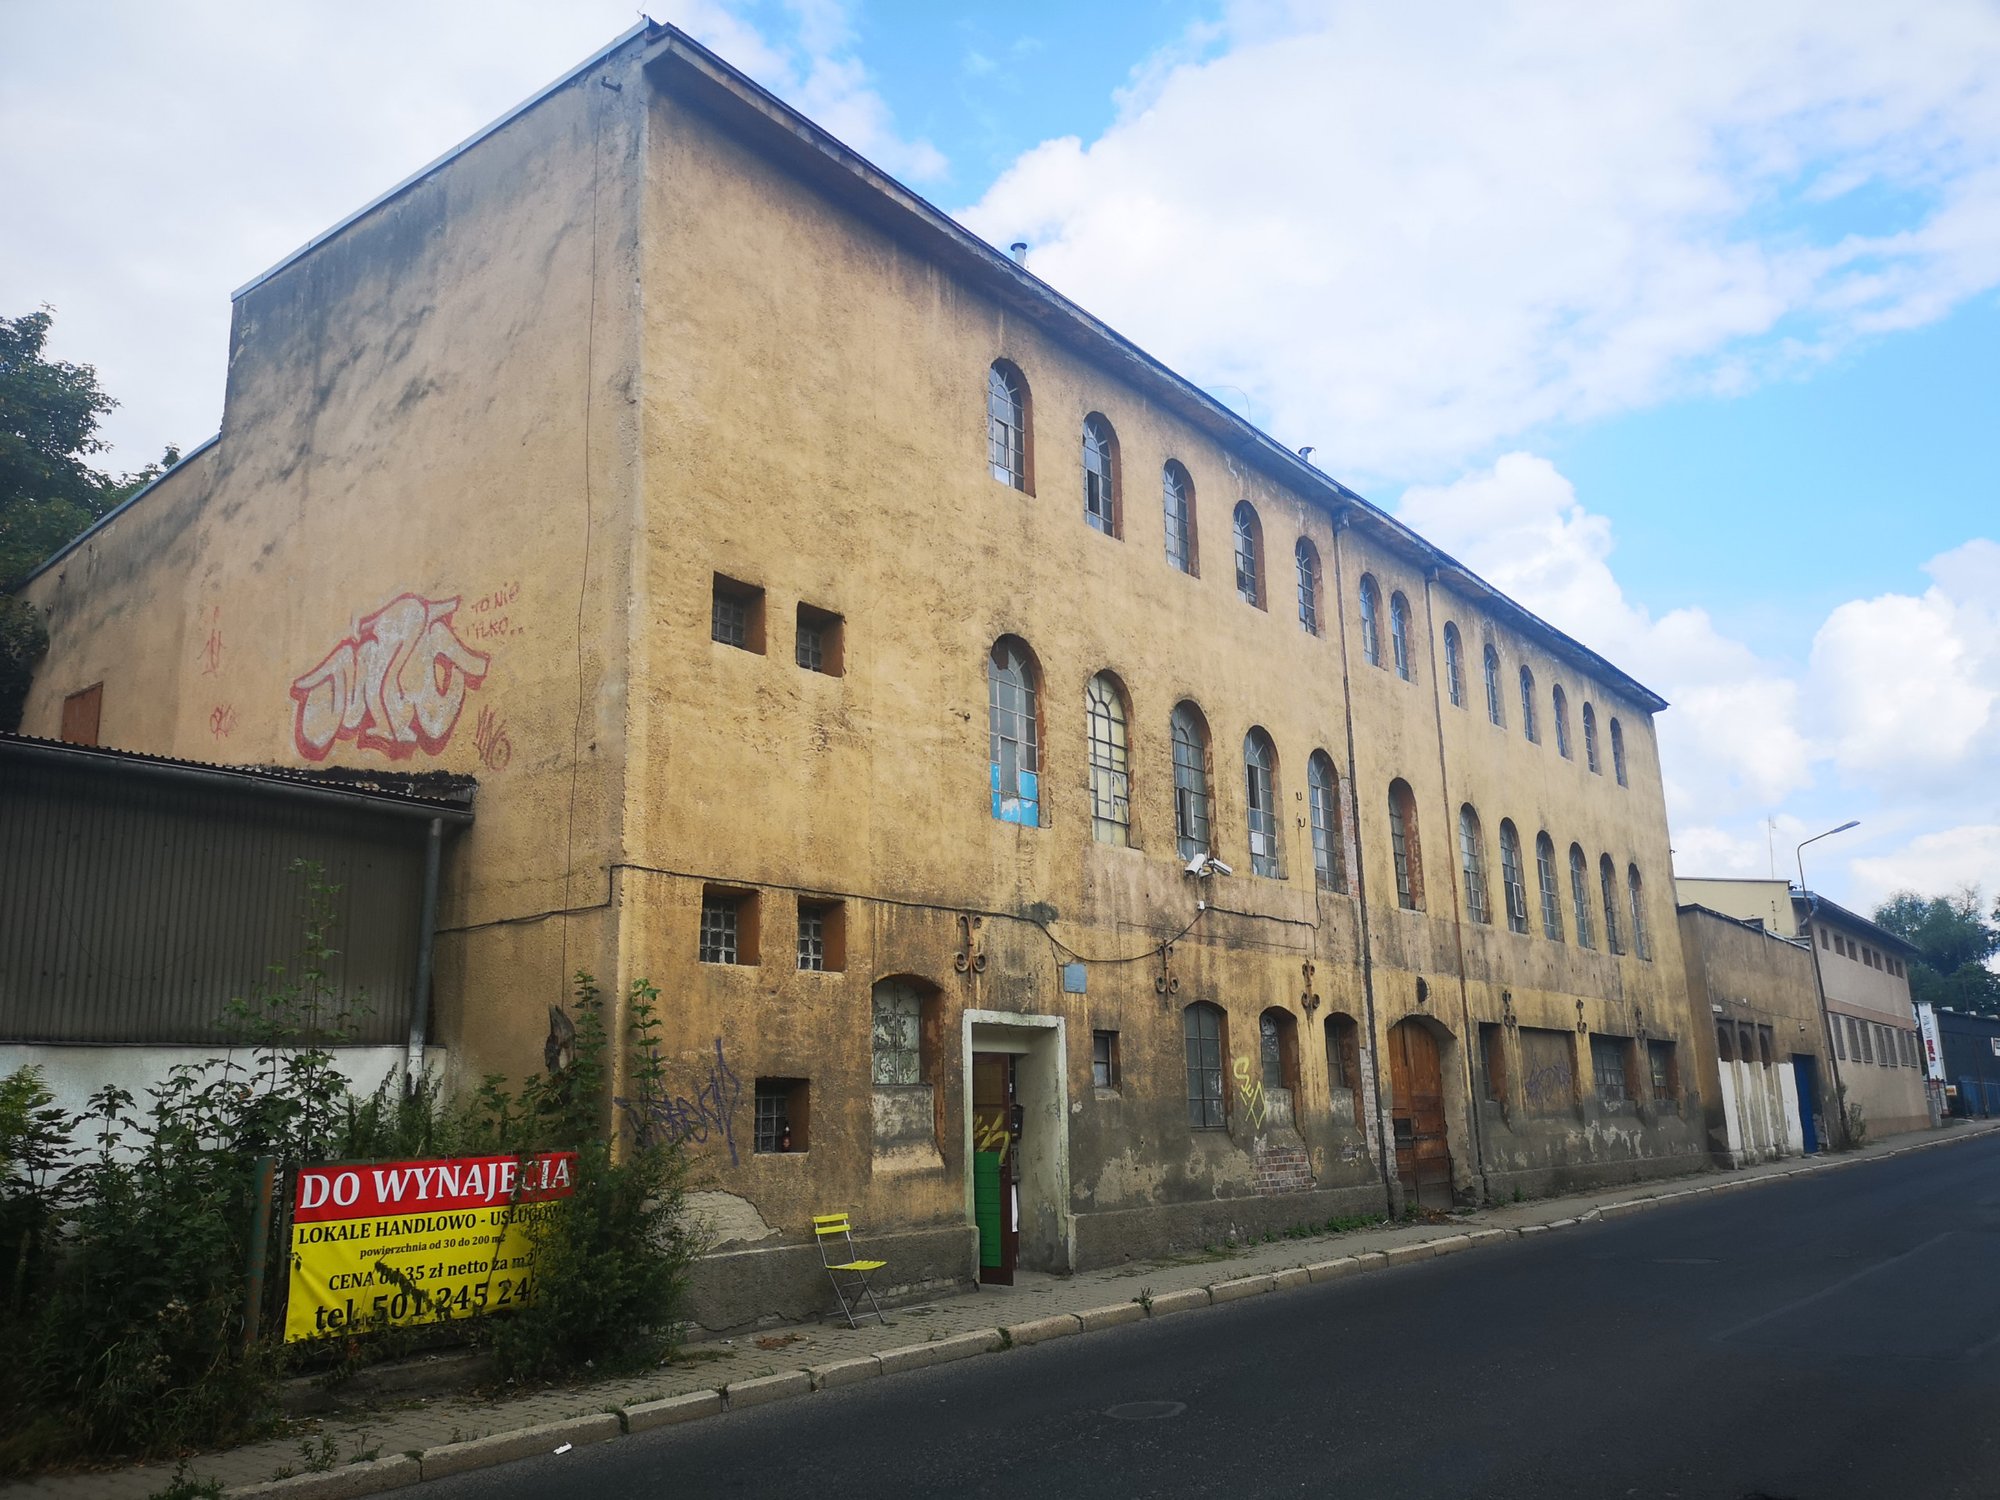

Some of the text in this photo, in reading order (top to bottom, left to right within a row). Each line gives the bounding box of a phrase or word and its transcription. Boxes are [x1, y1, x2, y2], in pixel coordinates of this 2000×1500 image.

[300, 1172, 360, 1209] DO
[298, 1222, 371, 1245] LOKALE
[375, 1213, 477, 1238] HANDLOWO
[360, 1241, 427, 1260] powierzchnia
[429, 1239, 442, 1250] od
[444, 1238, 456, 1249] 30
[458, 1237, 470, 1247] do
[472, 1235, 490, 1246] 200
[328, 1271, 375, 1291] CENA
[405, 1265, 425, 1281] 35
[429, 1262, 443, 1279] zł
[447, 1260, 488, 1277] netto
[492, 1258, 508, 1271] za
